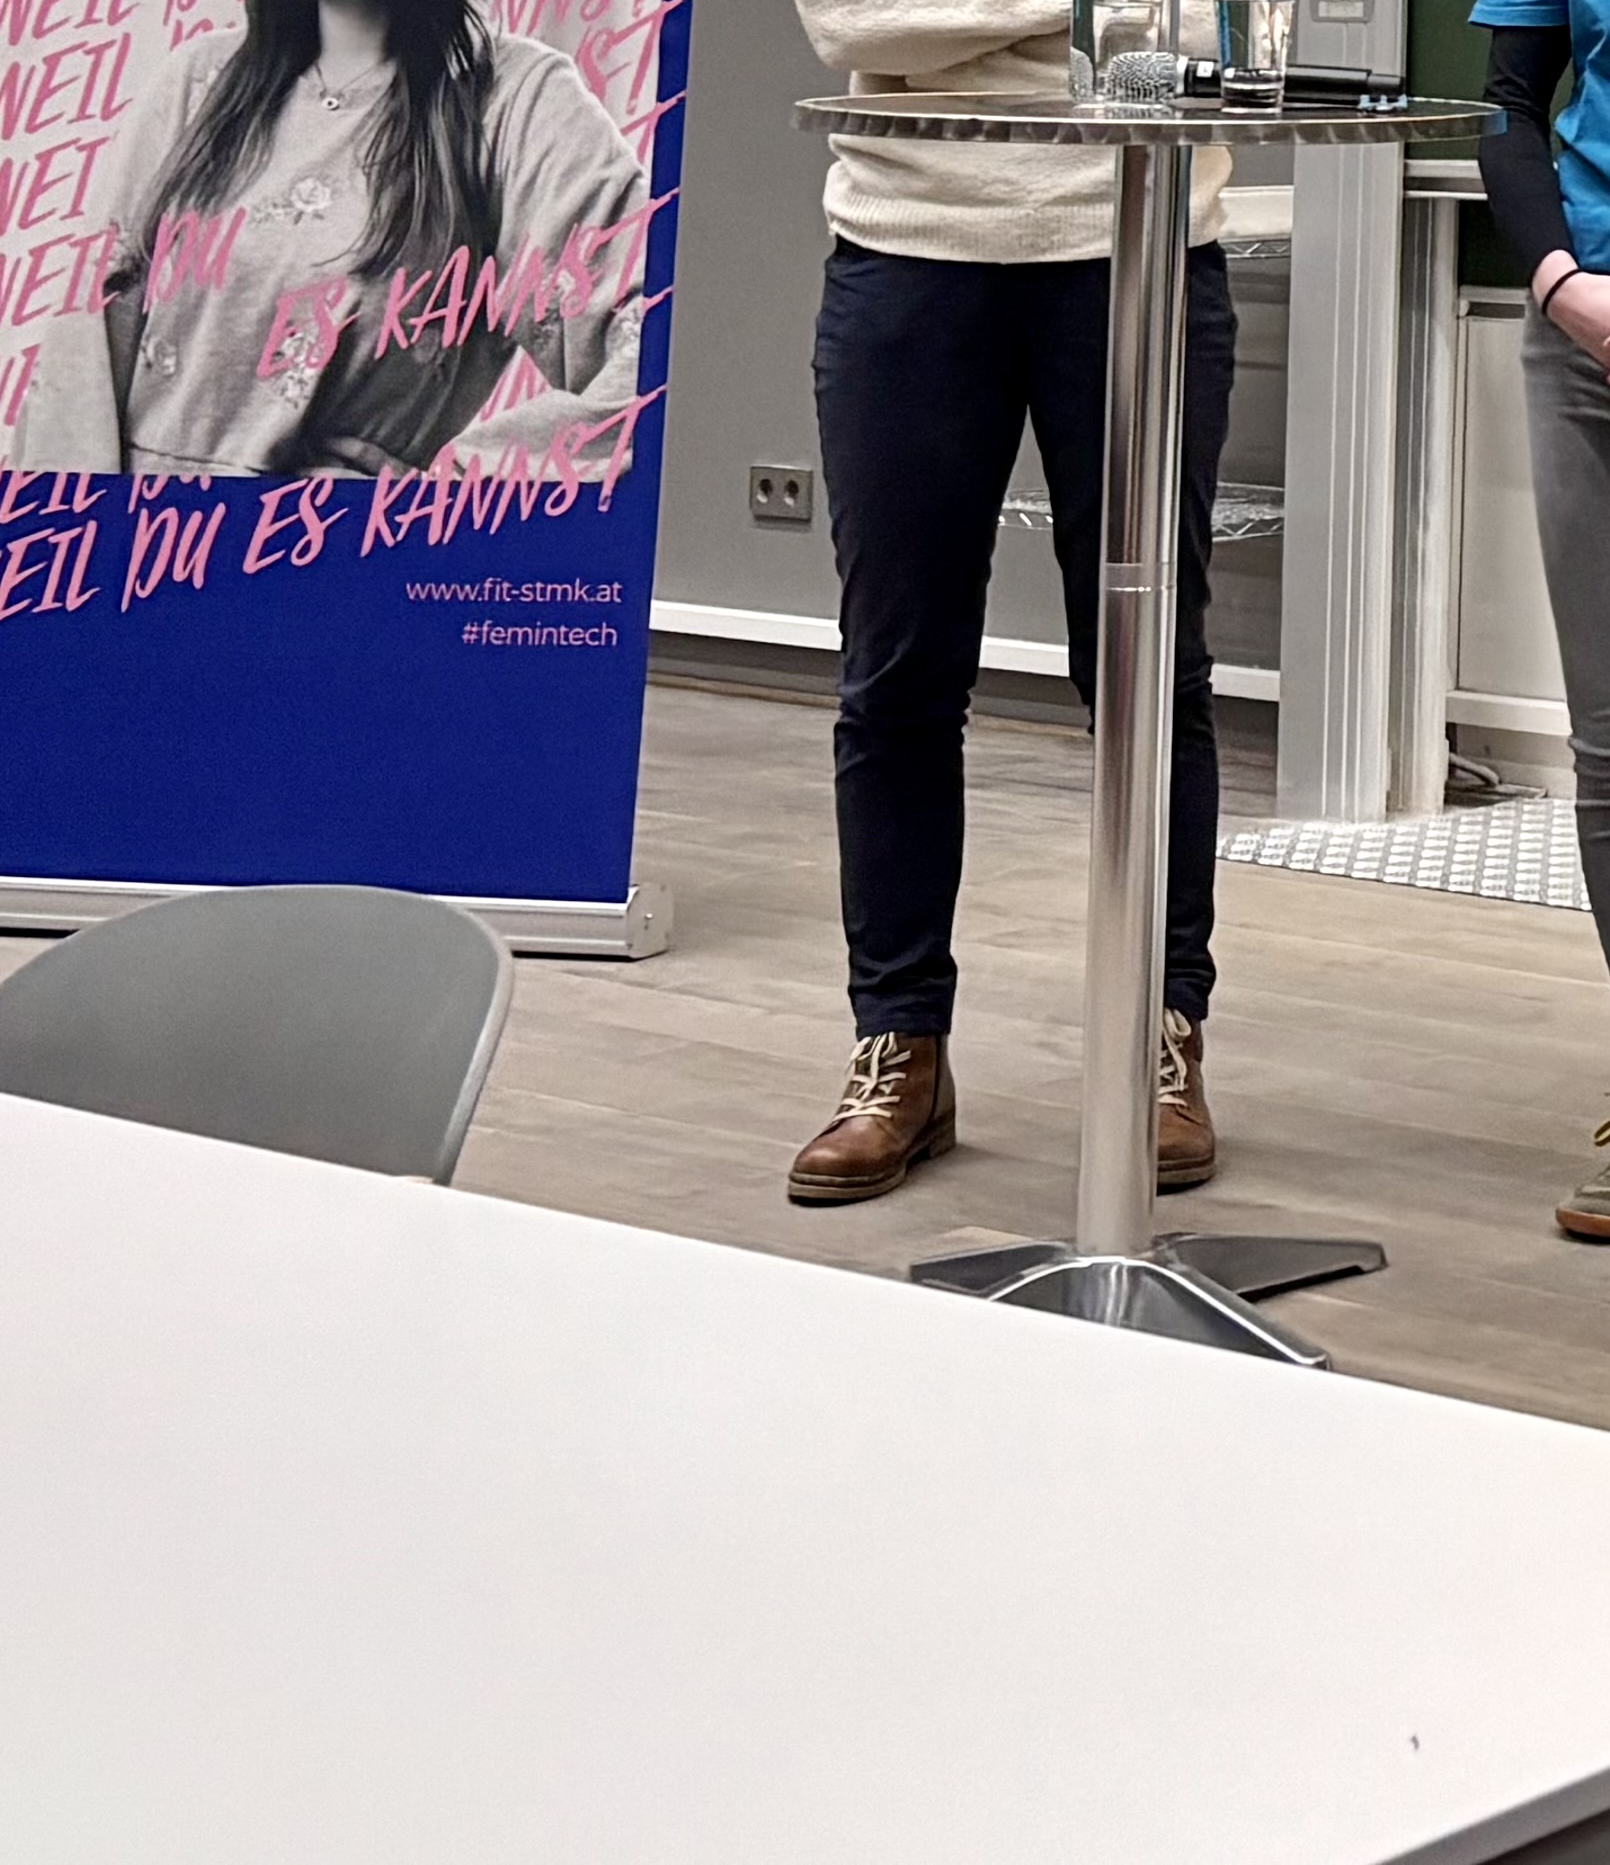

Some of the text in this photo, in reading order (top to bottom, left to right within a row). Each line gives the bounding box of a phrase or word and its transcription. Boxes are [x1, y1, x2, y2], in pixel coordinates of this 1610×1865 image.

[142, 206, 247, 315] DU
[374, 188, 680, 361] KANNST
[0, 519, 101, 622] EIL
[121, 502, 226, 613] DU
[242, 472, 349, 575] ES
[359, 385, 668, 558] KANNST
[405, 577, 623, 603] www.fit-stmk.at
[461, 620, 618, 647] #femintech
